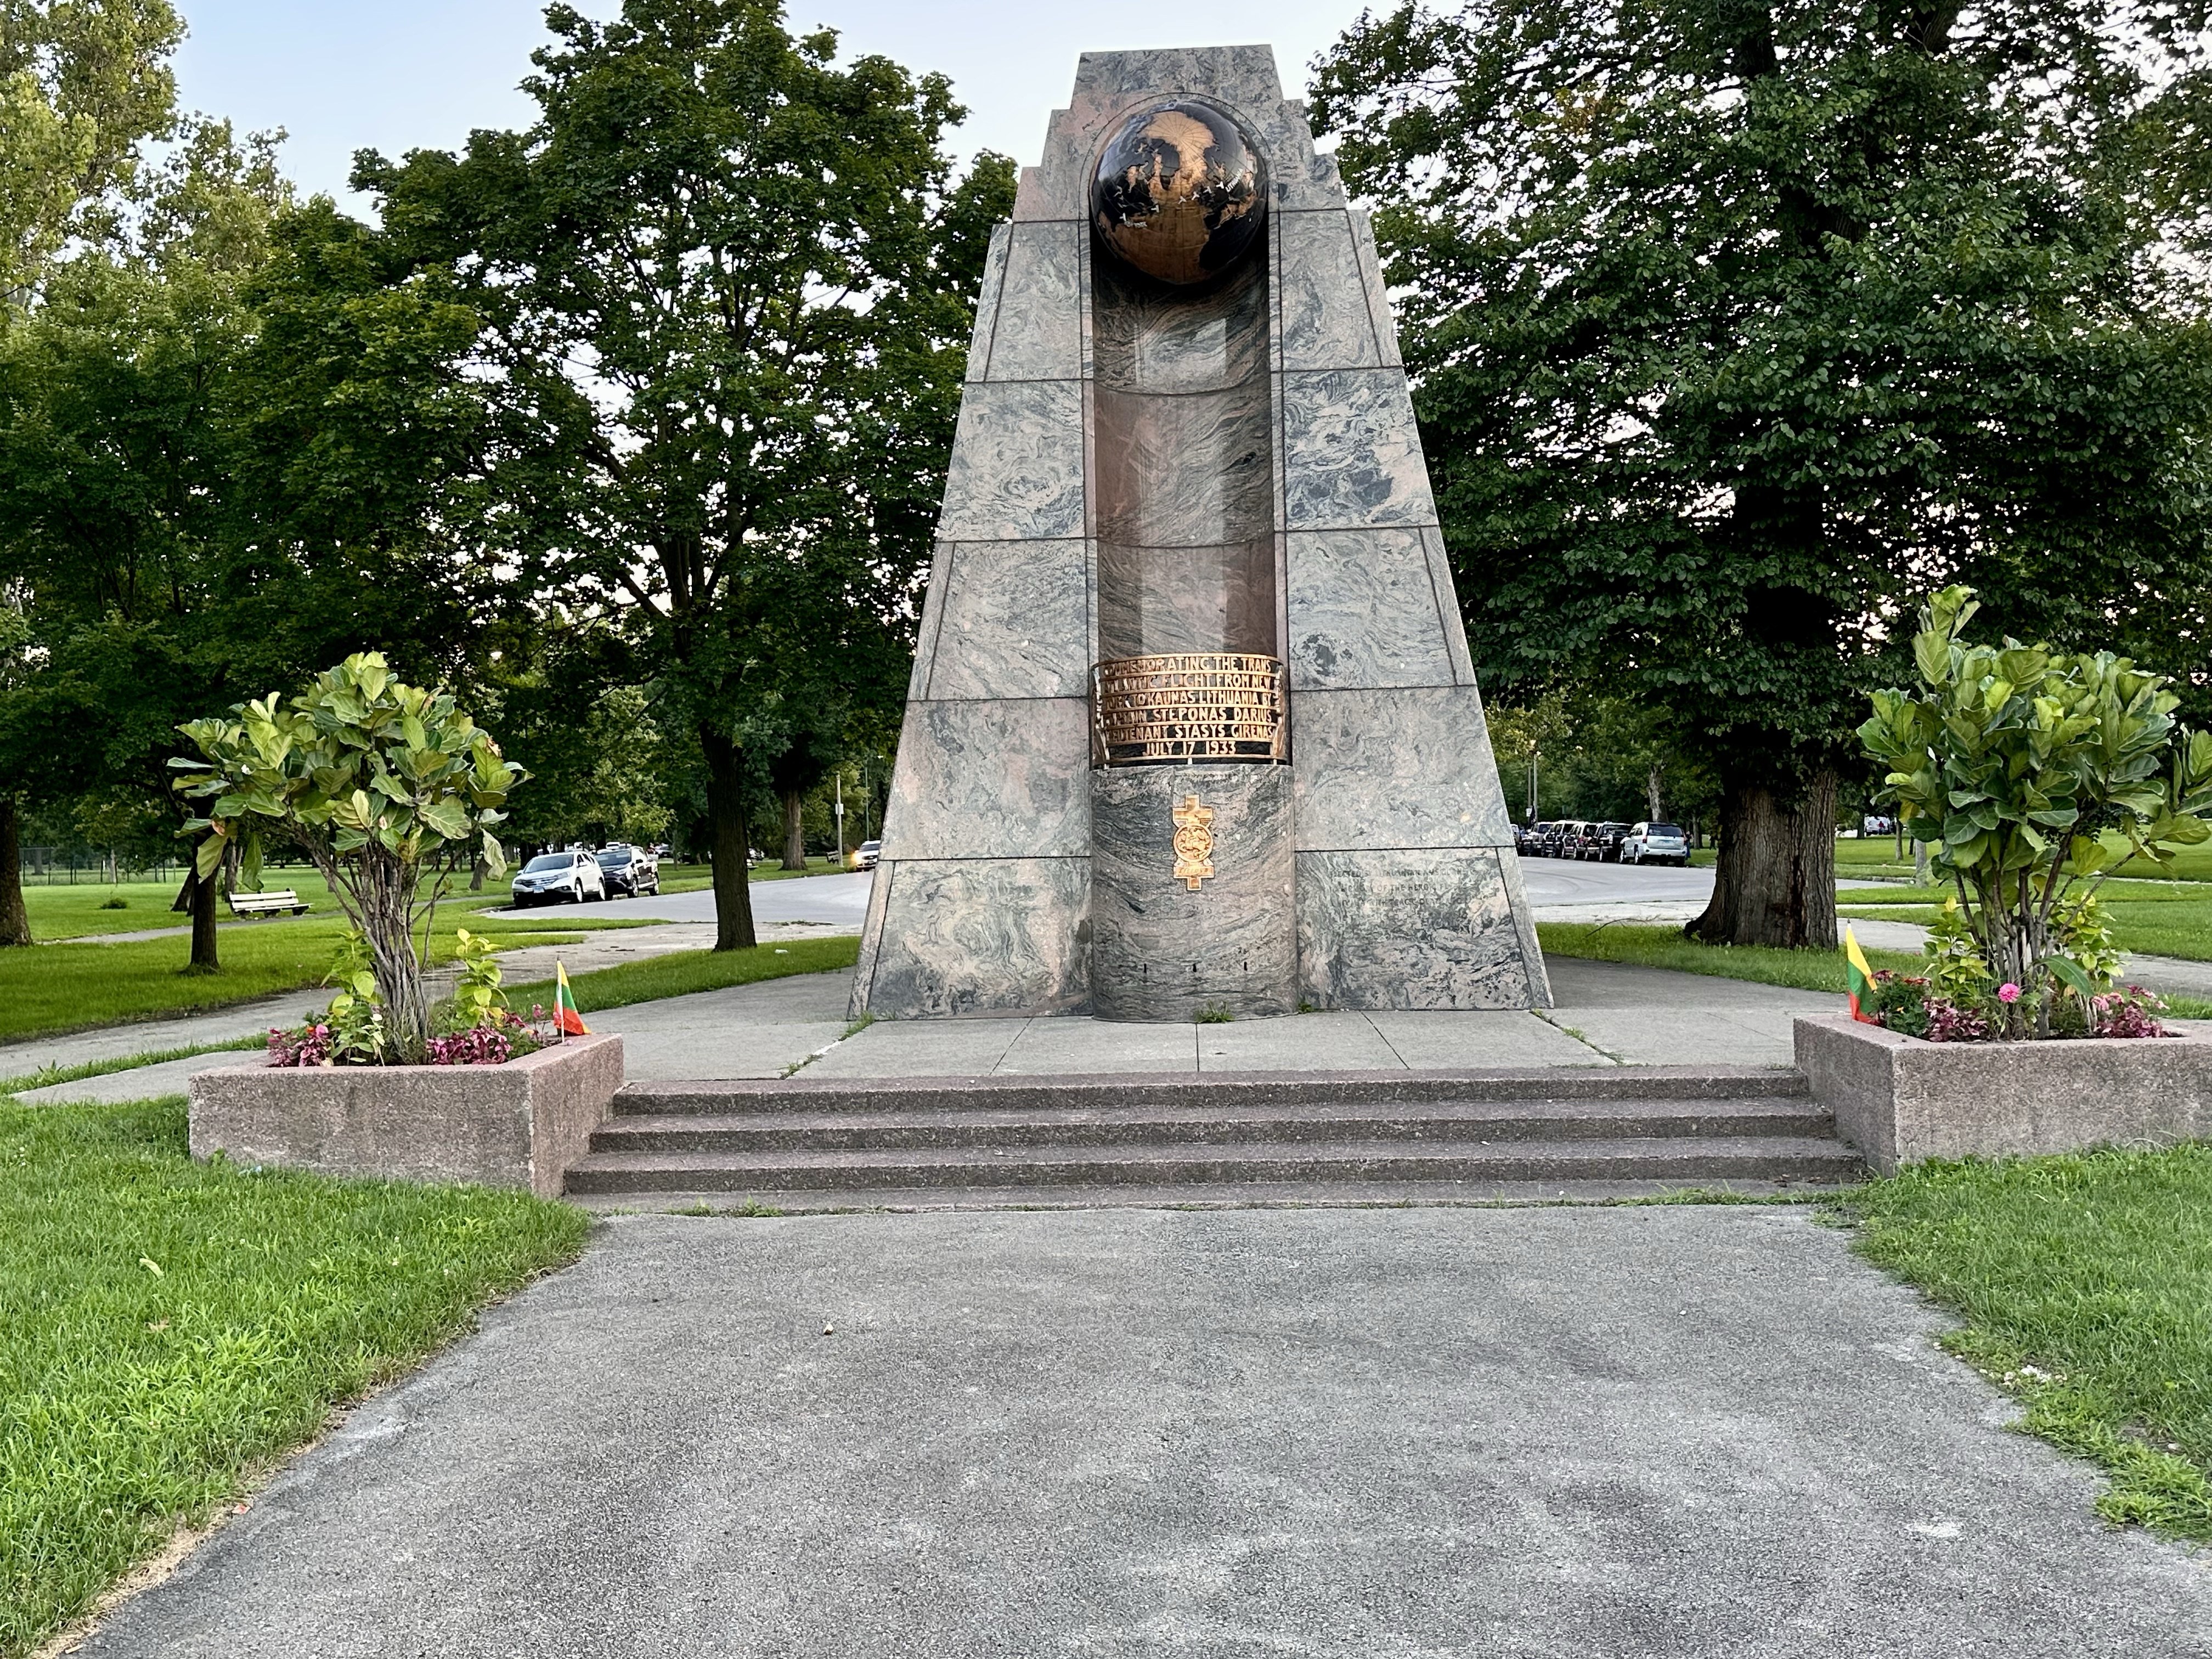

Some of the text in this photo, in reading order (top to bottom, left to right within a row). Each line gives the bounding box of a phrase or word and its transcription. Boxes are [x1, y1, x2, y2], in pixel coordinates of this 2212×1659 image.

[1213, 657, 1238, 670] THE
[1241, 658, 1271, 673] TRANS
[1162, 674, 1212, 688] FLIGHT
[1216, 674, 1249, 687] FROM
[1252, 675, 1271, 689] NEW
[1132, 693, 1146, 707] TO
[1148, 691, 1196, 705] KAUNAS
[1199, 691, 1259, 704] LITHUANIA
[1262, 693, 1271, 707] BY
[1153, 707, 1227, 722] STEPONAS
[1234, 707, 1272, 723] DARIUS
[1175, 725, 1225, 738] STASYS
[1231, 725, 1273, 738] GIRENAS
[1142, 741, 1236, 756] JULY 17 1933
